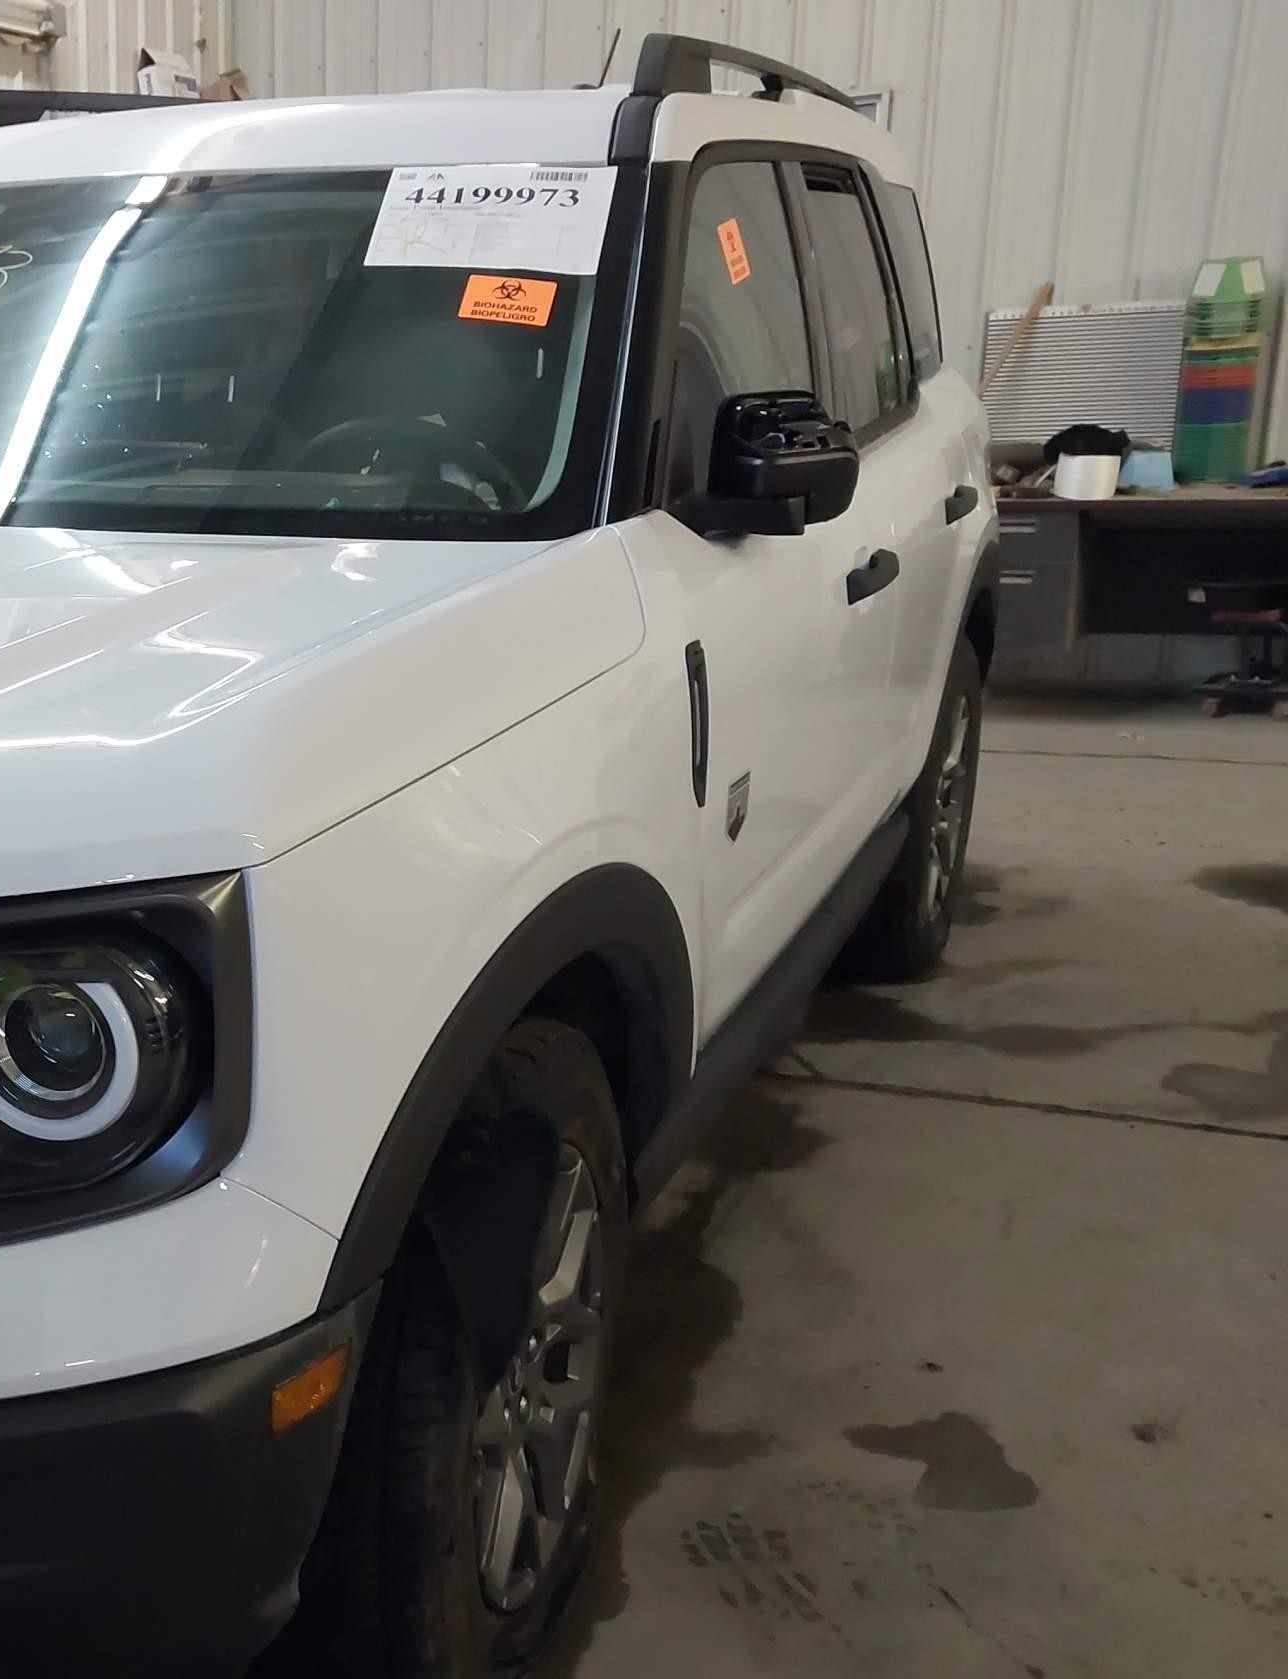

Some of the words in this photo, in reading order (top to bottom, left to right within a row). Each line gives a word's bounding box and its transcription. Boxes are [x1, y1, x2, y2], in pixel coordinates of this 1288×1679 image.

[405, 186, 580, 207] 44199973
[473, 301, 538, 313] BIOHAZARD
[470, 309, 536, 321] BIOPELIGRO
